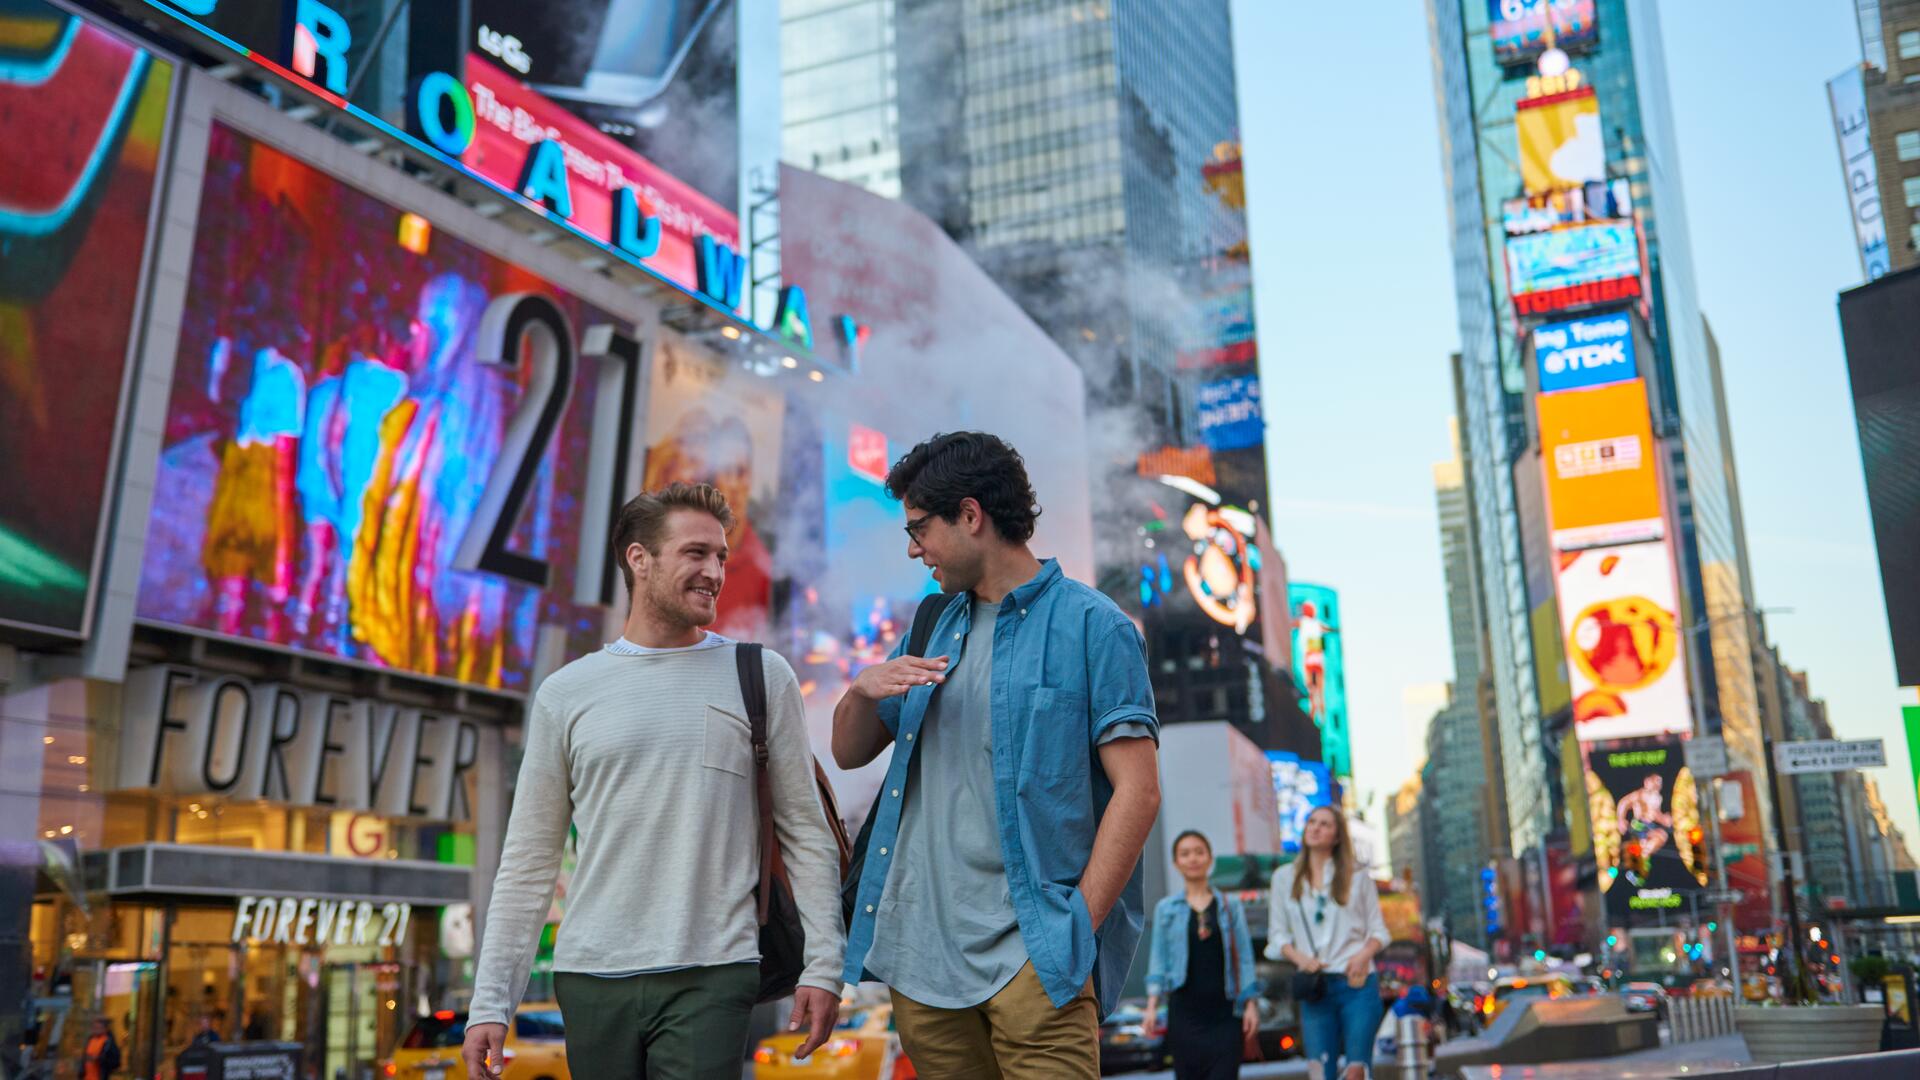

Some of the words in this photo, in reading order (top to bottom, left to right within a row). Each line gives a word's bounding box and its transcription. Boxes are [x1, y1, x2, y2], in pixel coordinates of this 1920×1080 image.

[165, 0, 871, 376] ROADWAY
[1513, 276, 1641, 314] TOSHIBA
[1563, 340, 1626, 372] TDK
[466, 294, 642, 604] 21
[144, 667, 481, 821] FOREVER
[232, 896, 373, 946] FOREVER
[378, 902, 412, 947] 21
